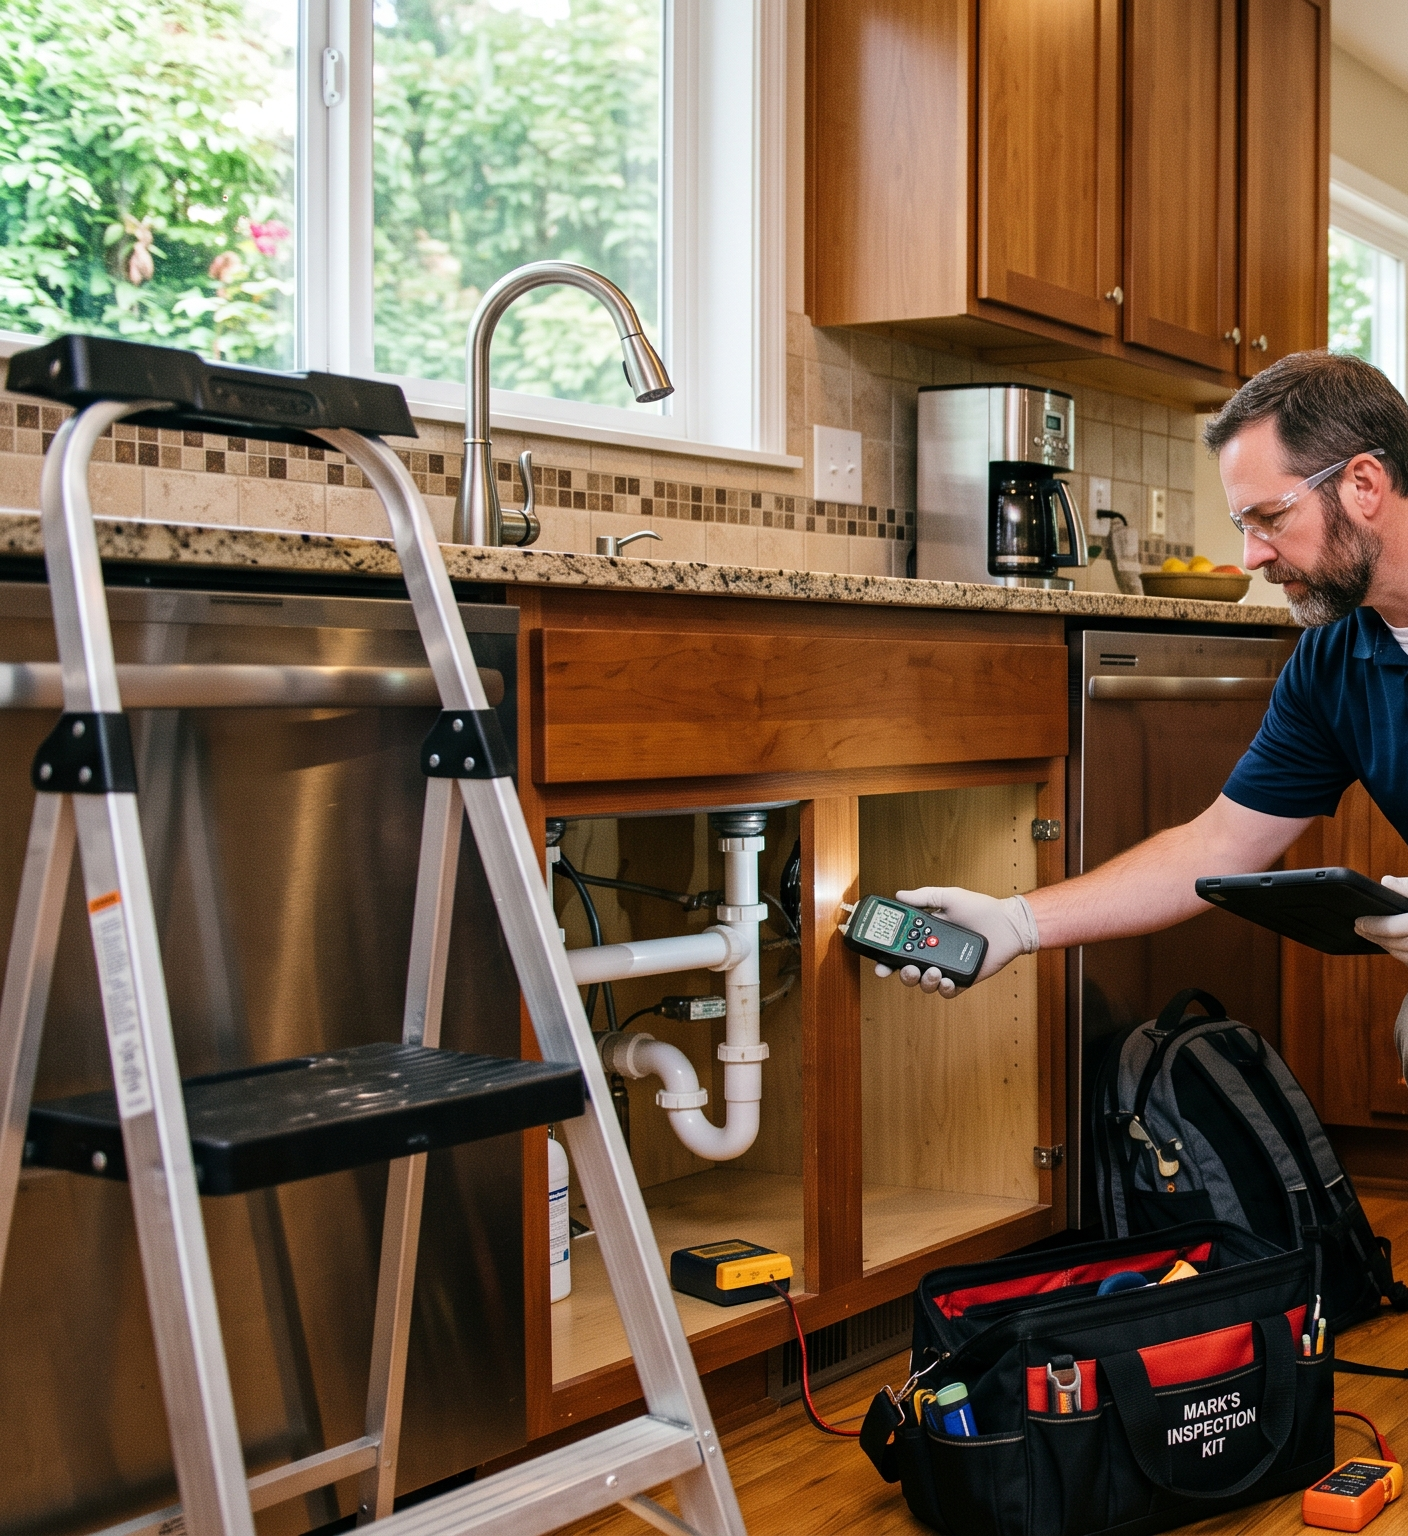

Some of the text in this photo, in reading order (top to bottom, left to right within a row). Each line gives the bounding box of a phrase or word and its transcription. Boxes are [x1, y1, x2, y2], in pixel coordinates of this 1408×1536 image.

[1183, 1391, 1241, 1421] MARK'S
[1167, 1406, 1256, 1446] INSPECTION
[1202, 1437, 1226, 1458] KIT
